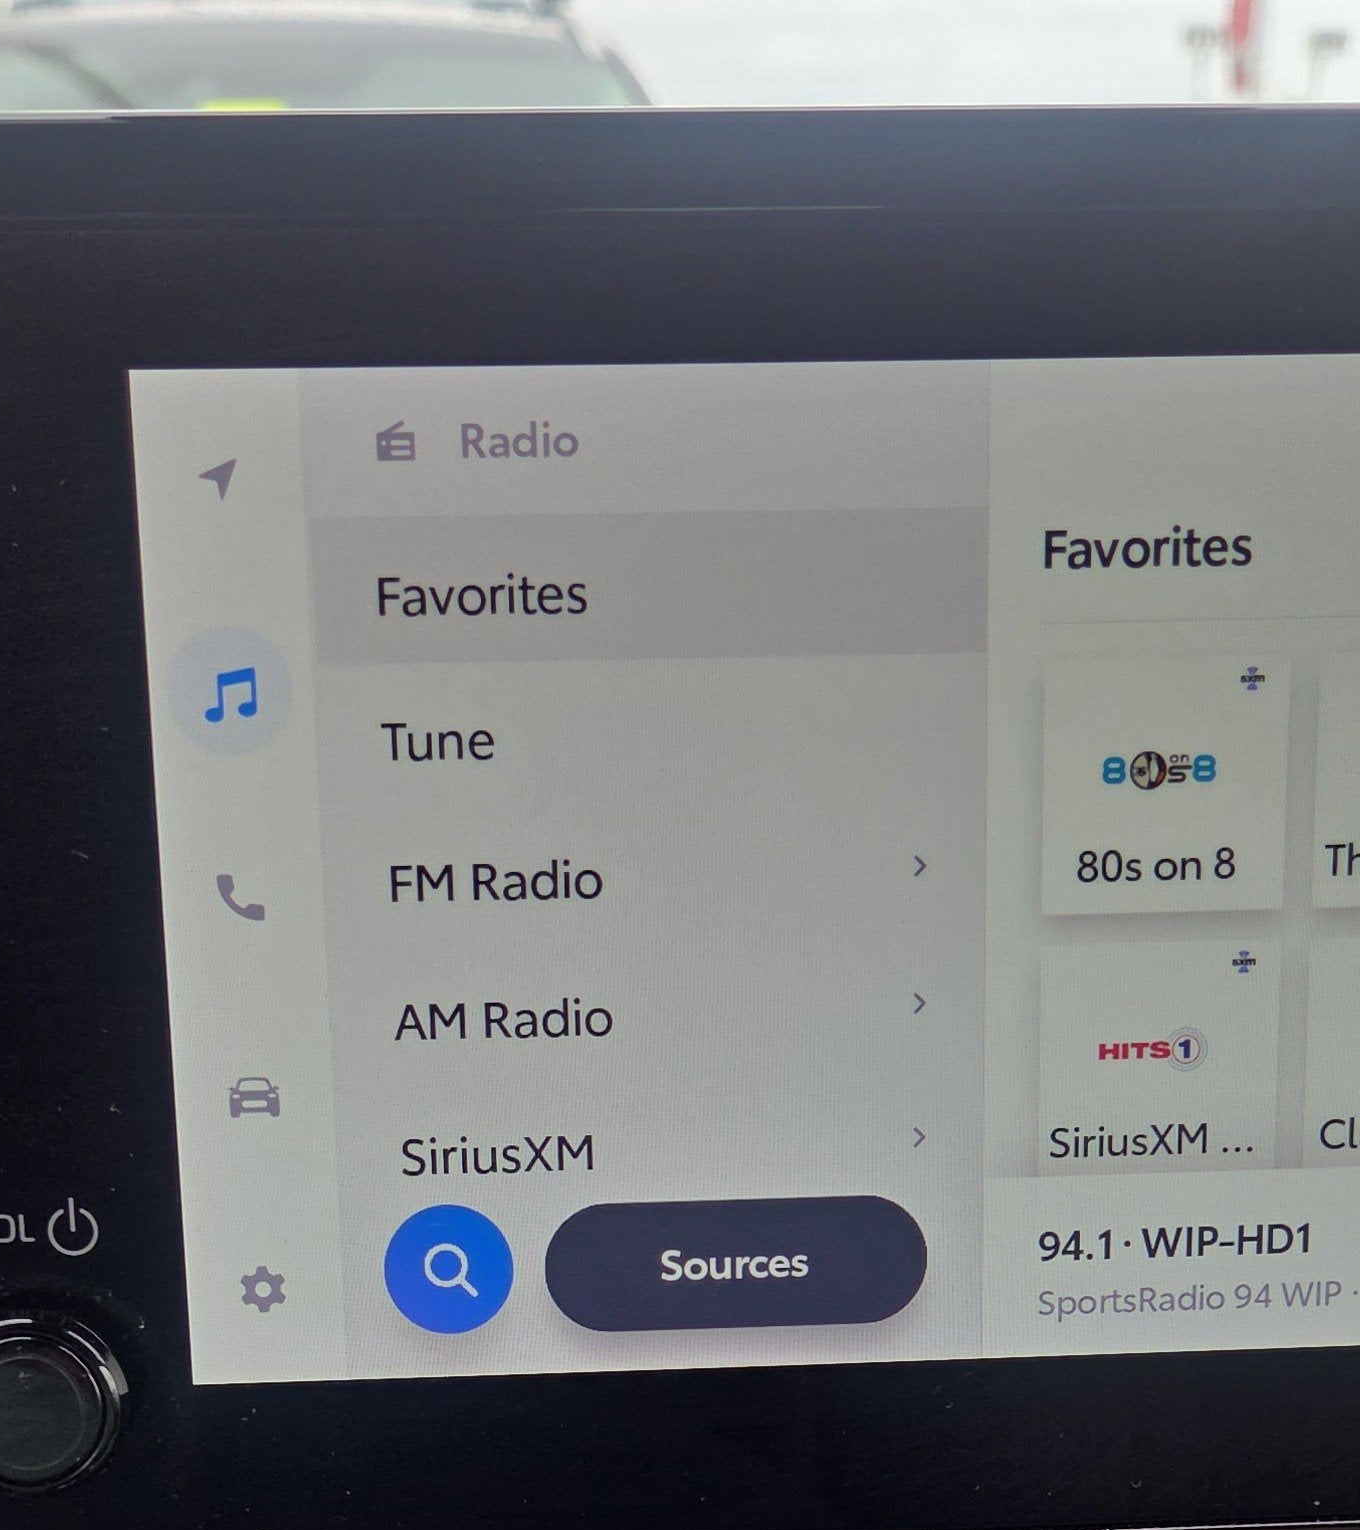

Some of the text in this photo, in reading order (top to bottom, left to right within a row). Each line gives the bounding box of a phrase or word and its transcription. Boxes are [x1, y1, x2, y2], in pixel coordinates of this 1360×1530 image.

[460, 421, 579, 459] Radio
[1044, 526, 1252, 570] Favorites
[377, 573, 587, 616] Favorites
[382, 722, 495, 762] Tune
[390, 860, 604, 903] FM Radio
[1077, 848, 1237, 883] 80s on 8
[395, 998, 614, 1041] AM Radio
[401, 1134, 596, 1176] SiriusXM
[1049, 1122, 1209, 1160] SiriusXM
[1039, 1228, 1114, 1263] 94.1
[1142, 1224, 1313, 1259] WIP-HD1
[660, 1248, 809, 1283] Sources
[1038, 1284, 1226, 1324] SportsRadio
[1233, 1283, 1273, 1312] 94
[1281, 1281, 1344, 1310] WIP
